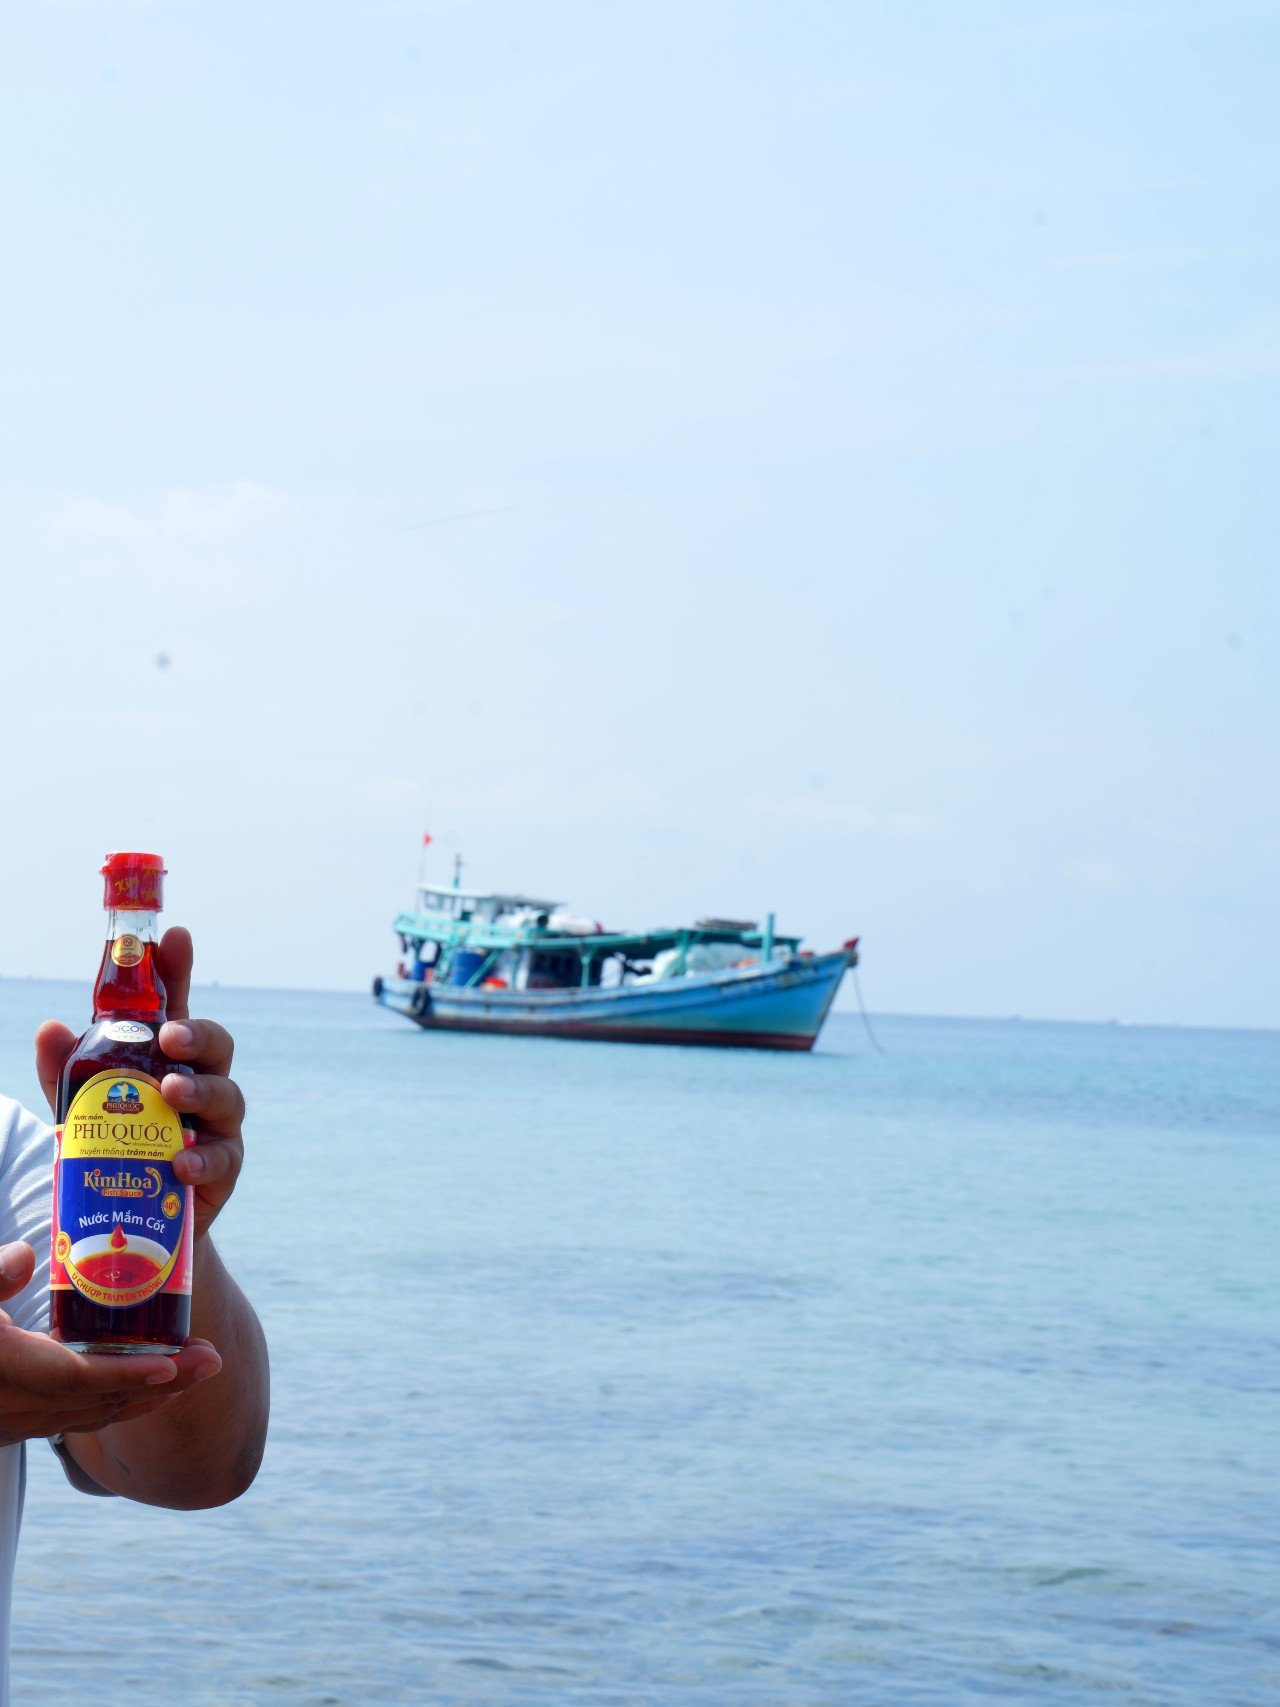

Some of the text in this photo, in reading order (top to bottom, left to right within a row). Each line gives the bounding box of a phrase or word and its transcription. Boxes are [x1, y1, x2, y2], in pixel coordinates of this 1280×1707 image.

[120, 1189, 142, 1197] Sauce
[78, 1209, 166, 1234] Nước Mắm Cốt
